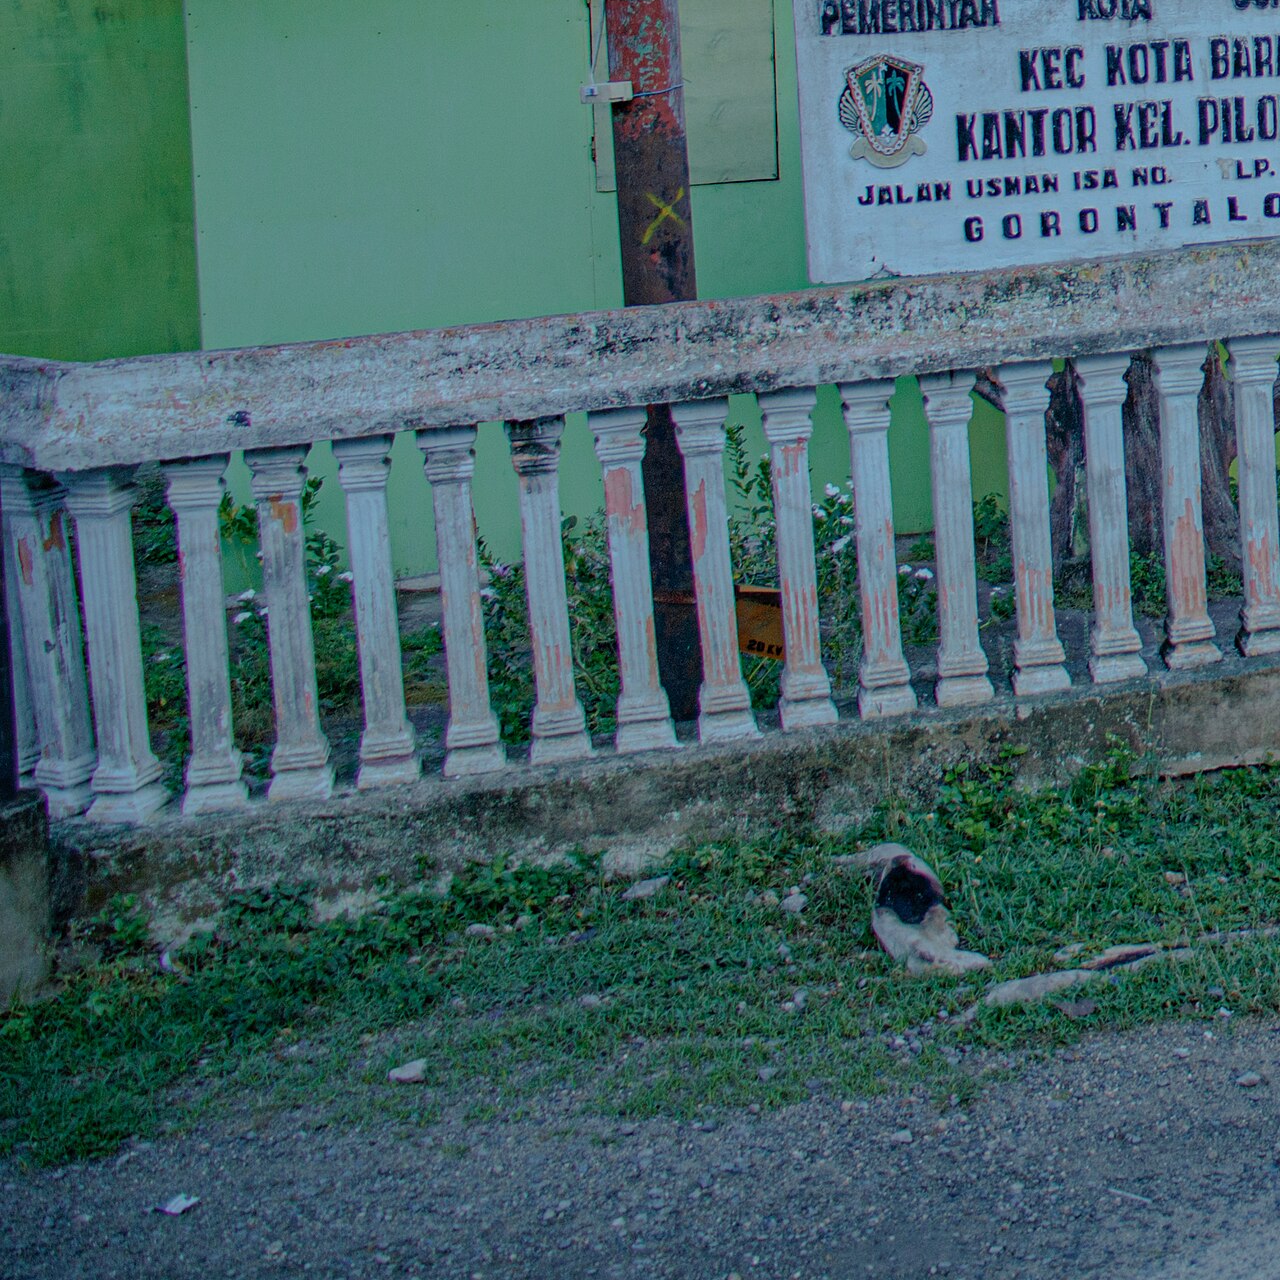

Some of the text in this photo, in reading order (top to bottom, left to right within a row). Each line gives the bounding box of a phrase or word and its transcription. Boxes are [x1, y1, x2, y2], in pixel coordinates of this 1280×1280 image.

[1018, 45, 1085, 92] KEC
[1105, 37, 1194, 86] KOTA
[956, 106, 1097, 162] KANTOR
[1114, 98, 1191, 150] KEL.
[858, 181, 951, 206] JALAN
[967, 173, 1059, 198] USMAN
[1073, 167, 1119, 190] ISA
[1132, 165, 1173, 187] NO.
